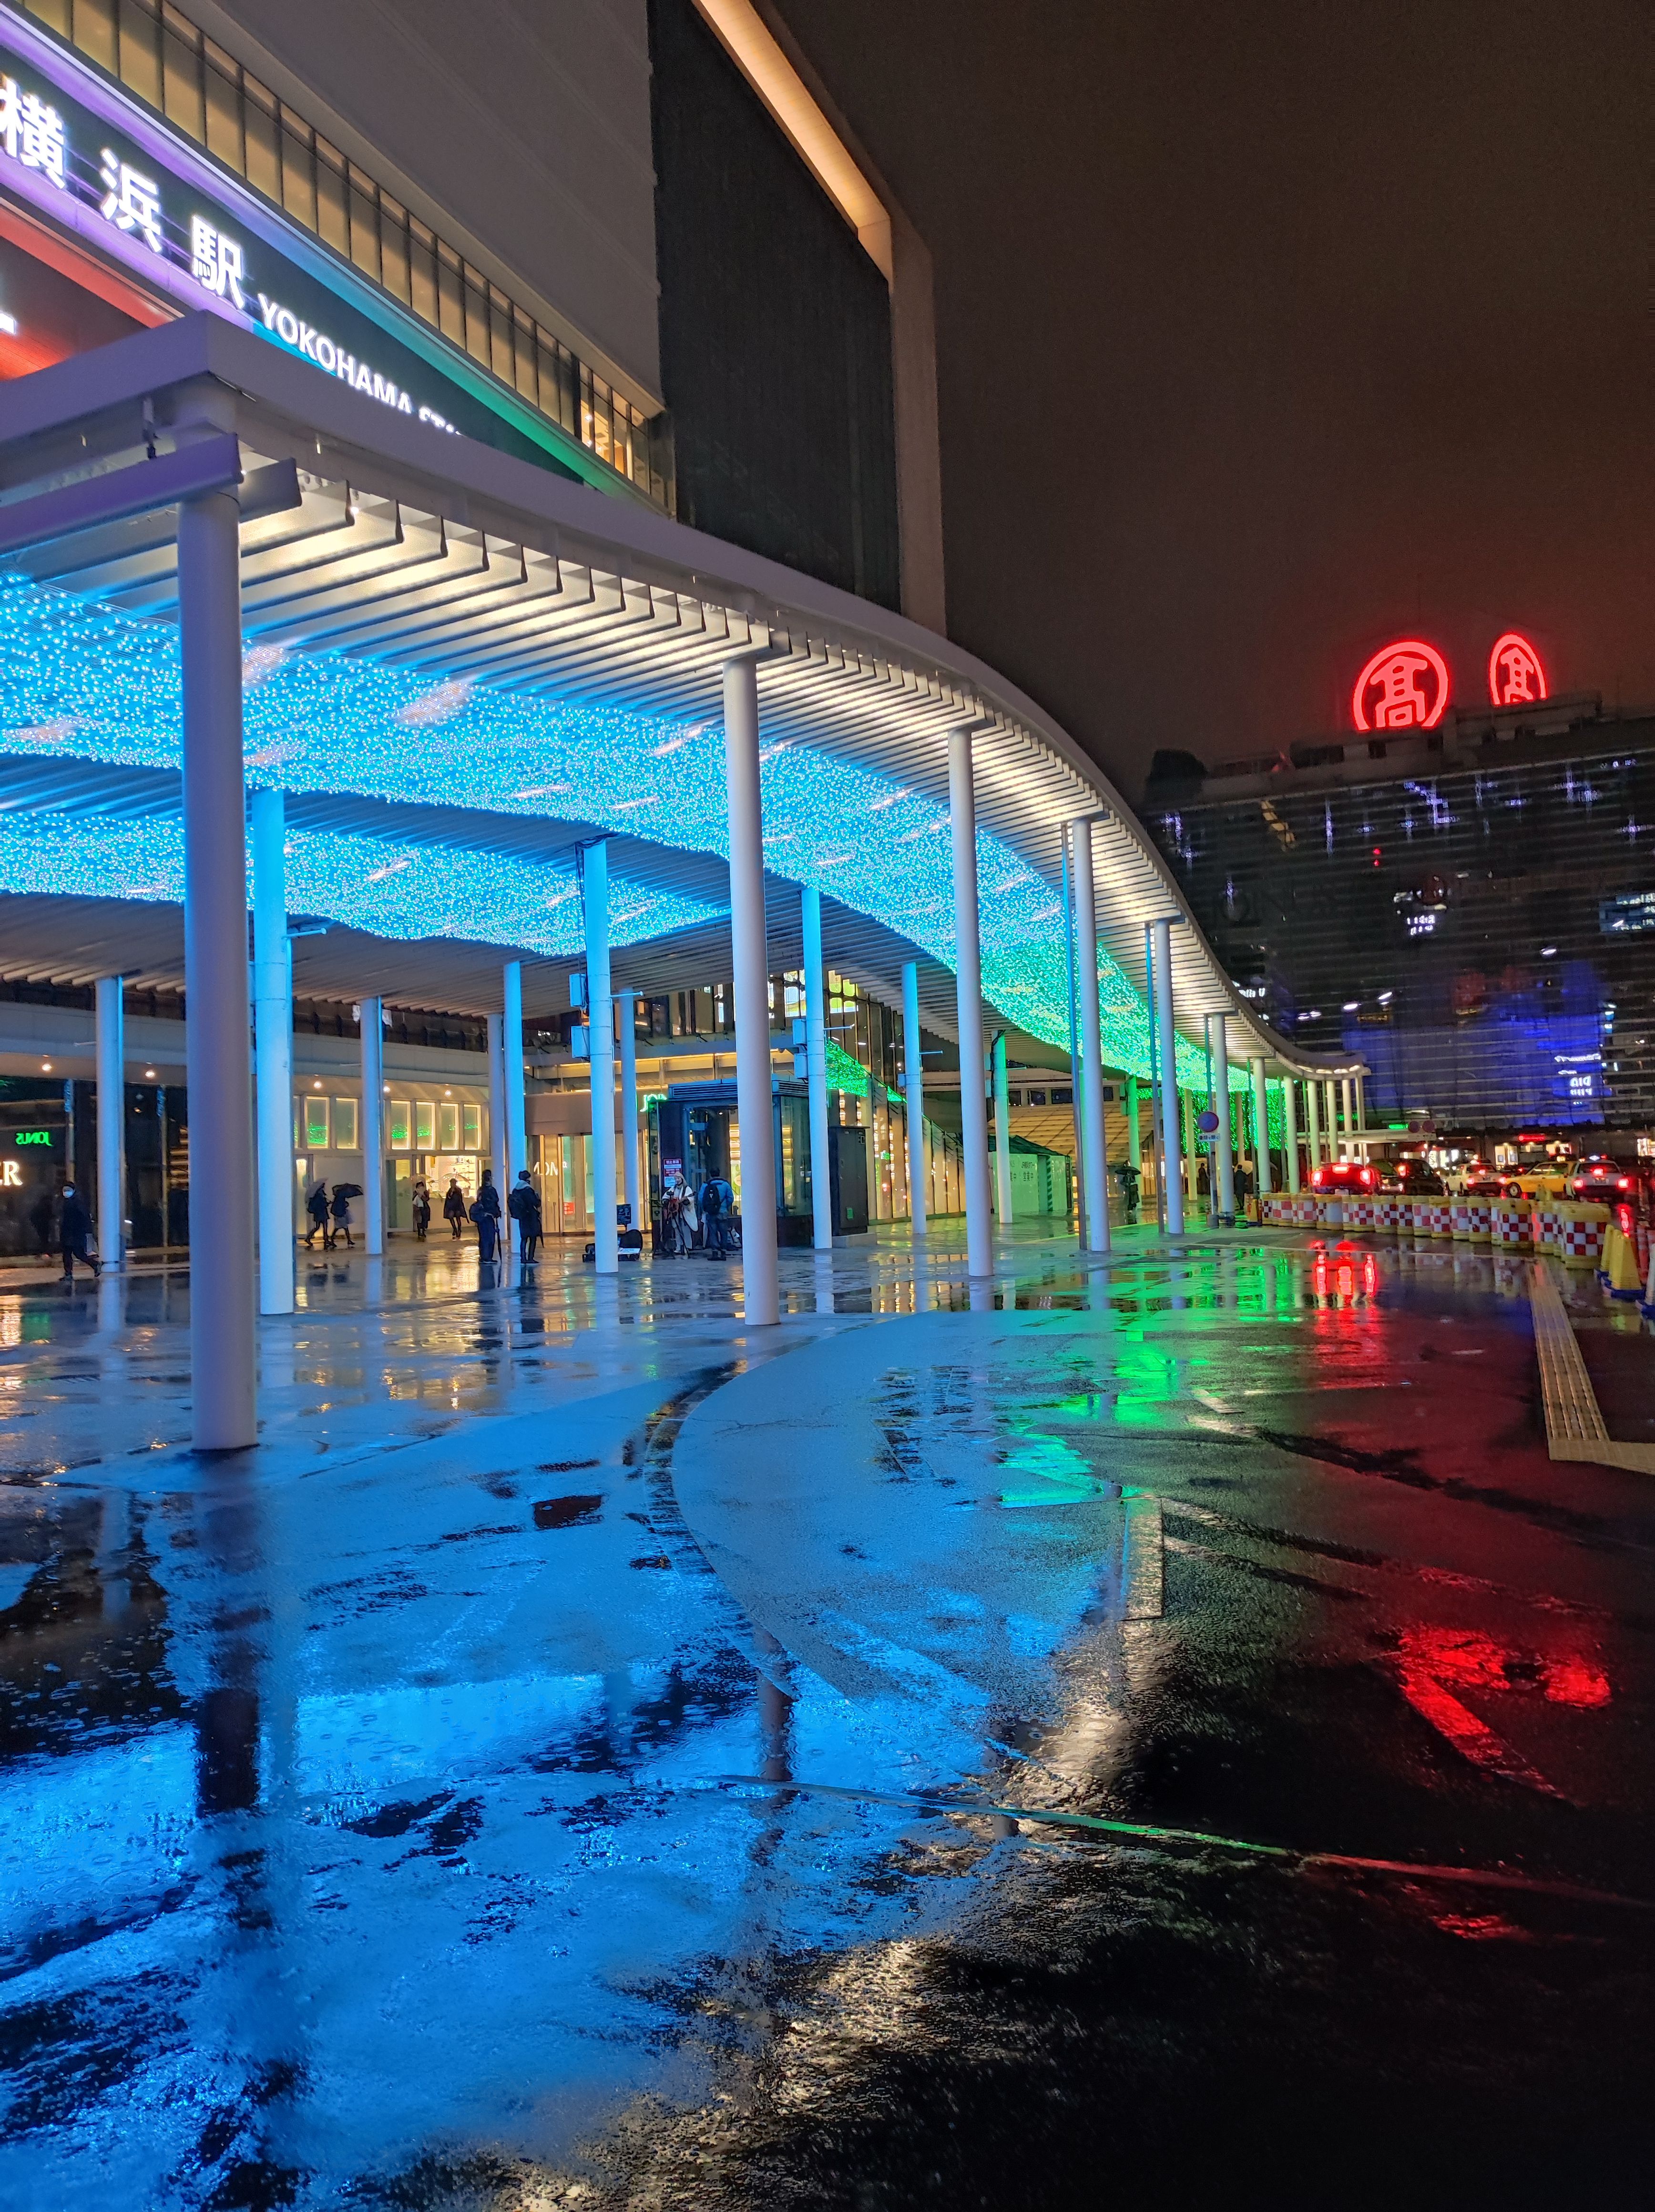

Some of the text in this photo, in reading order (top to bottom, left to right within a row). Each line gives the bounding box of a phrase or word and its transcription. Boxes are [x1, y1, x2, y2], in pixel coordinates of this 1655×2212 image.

[0, 77, 245, 310] 横浜駅
[257, 293, 411, 414] YOKOHAMA
